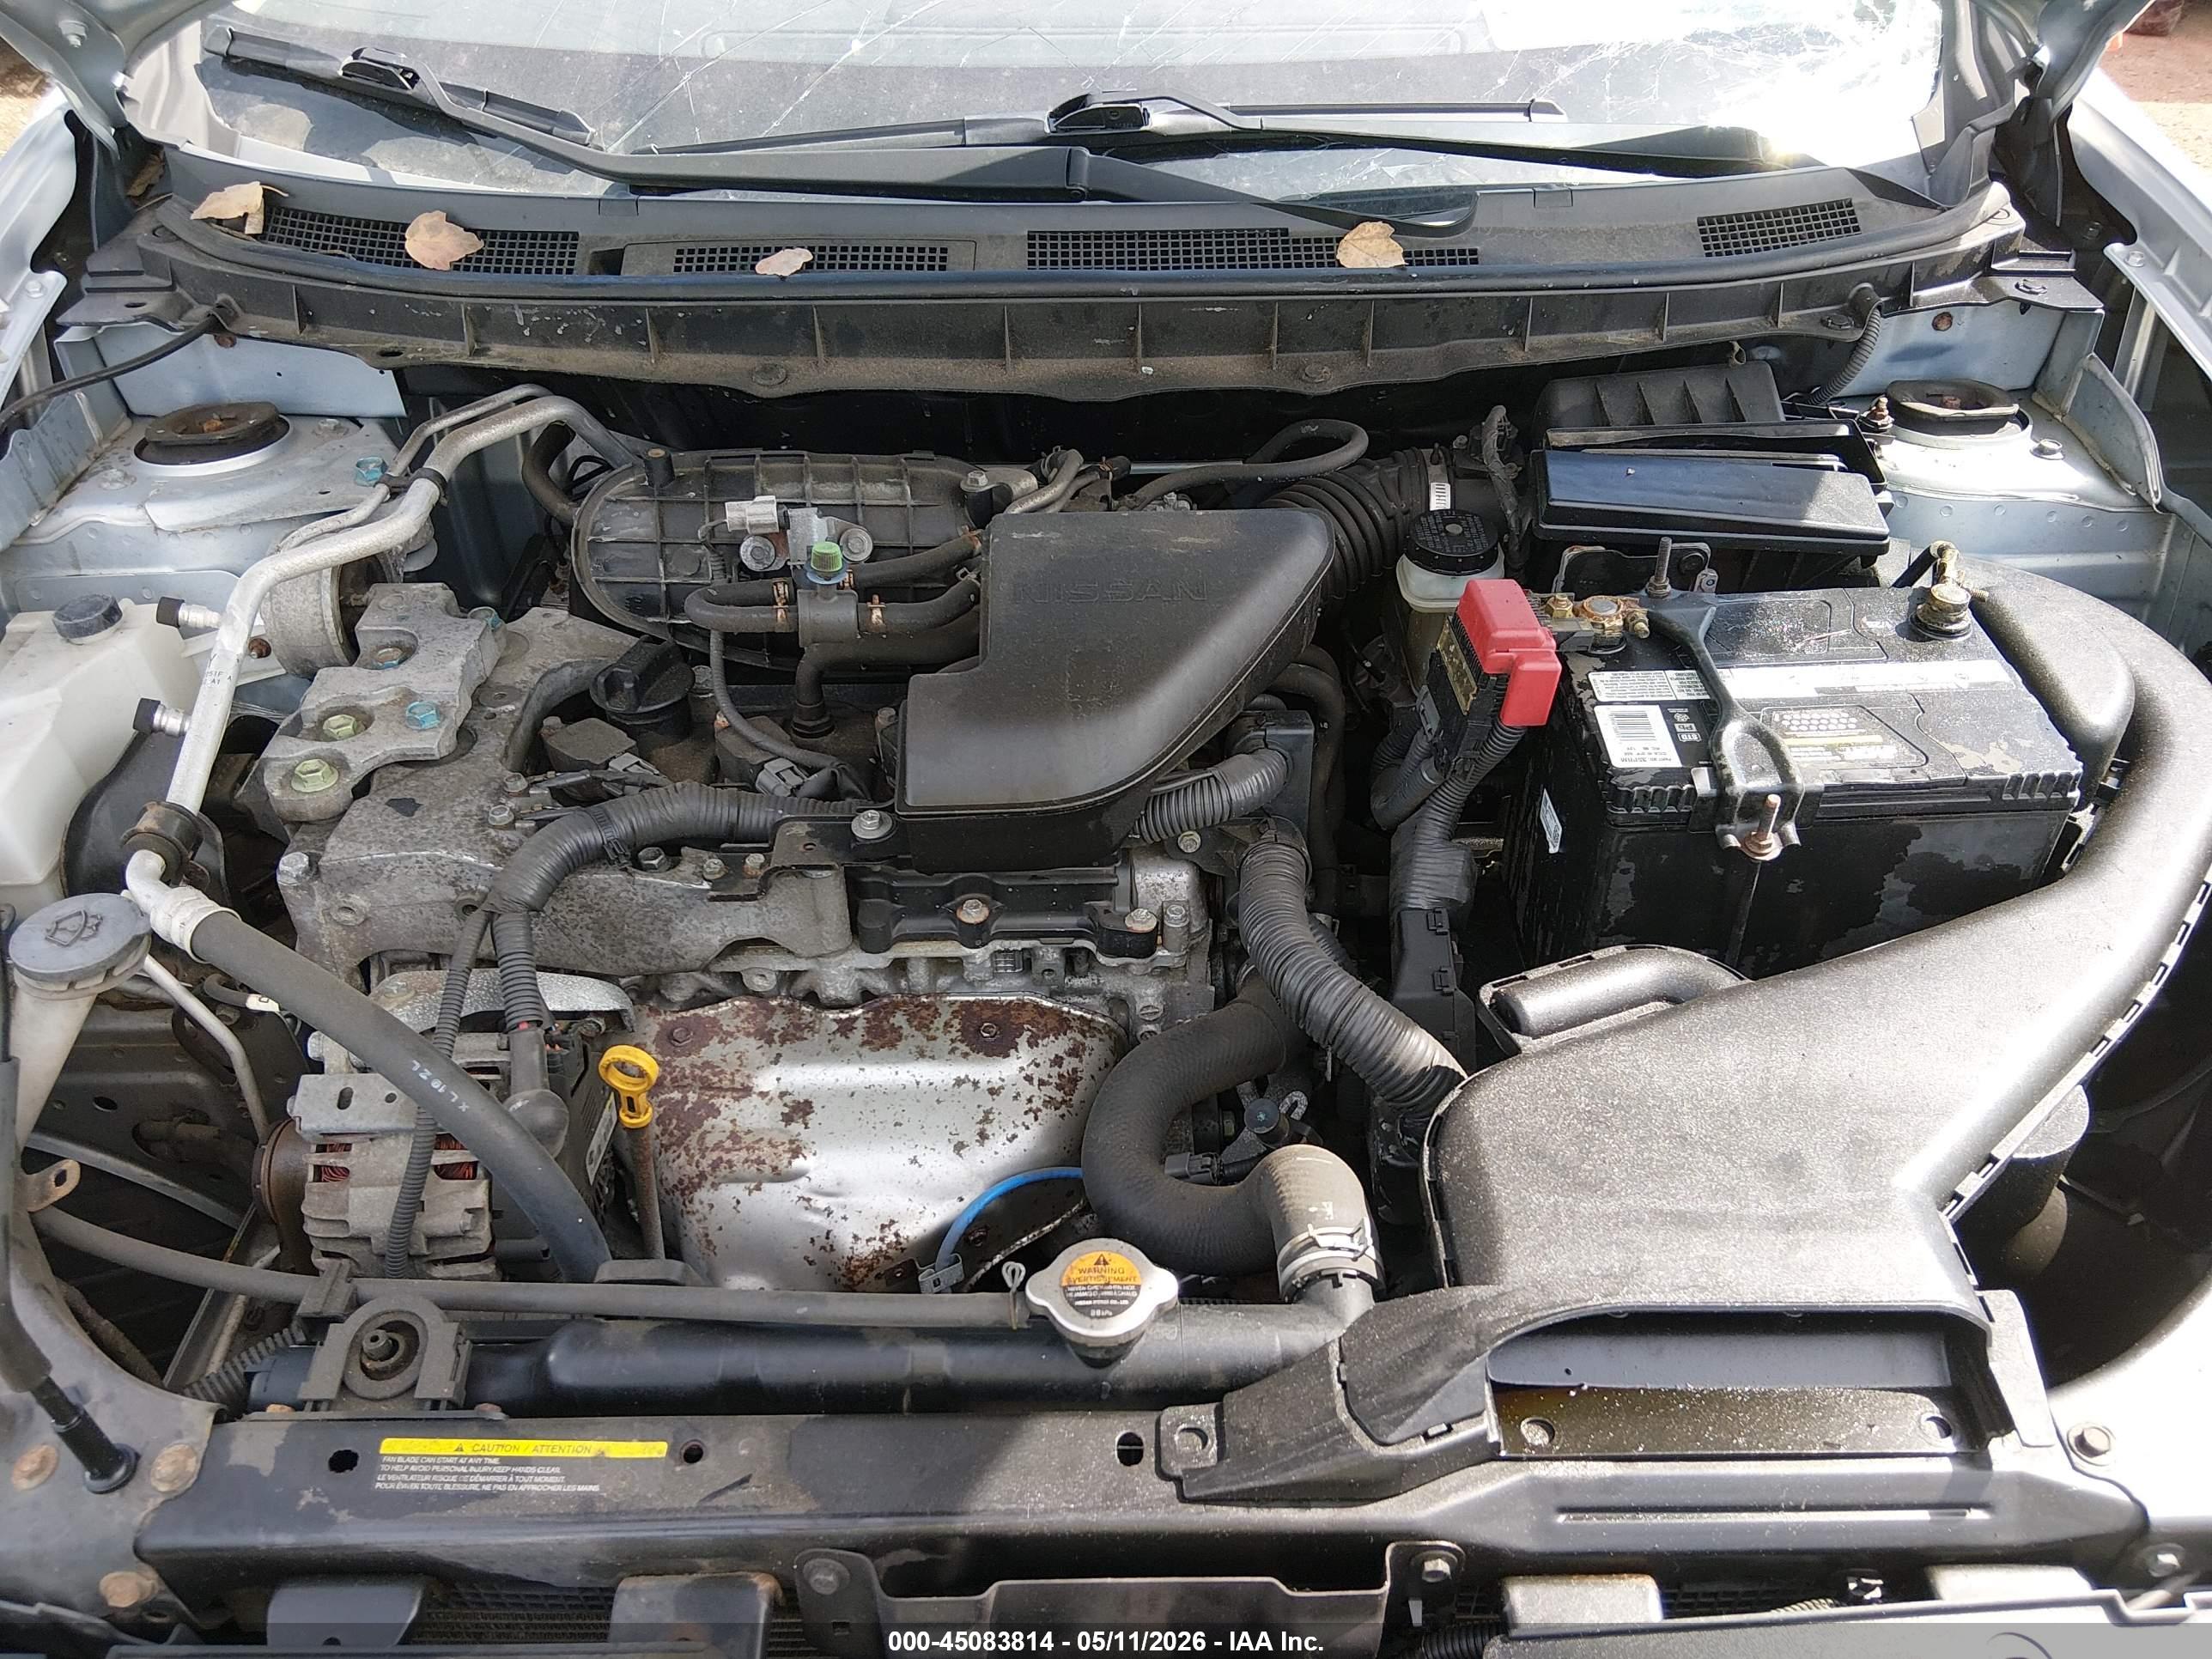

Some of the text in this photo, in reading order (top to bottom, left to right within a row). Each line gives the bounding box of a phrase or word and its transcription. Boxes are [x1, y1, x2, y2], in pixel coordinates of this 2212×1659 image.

[1013, 579, 1208, 602] NISSAN
[1078, 1267, 1126, 1275] WARNING
[471, 1443, 520, 1453] CAUTION
[532, 1444, 592, 1454] ATTENTION
[469, 1474, 508, 1482] DÉMARRER
